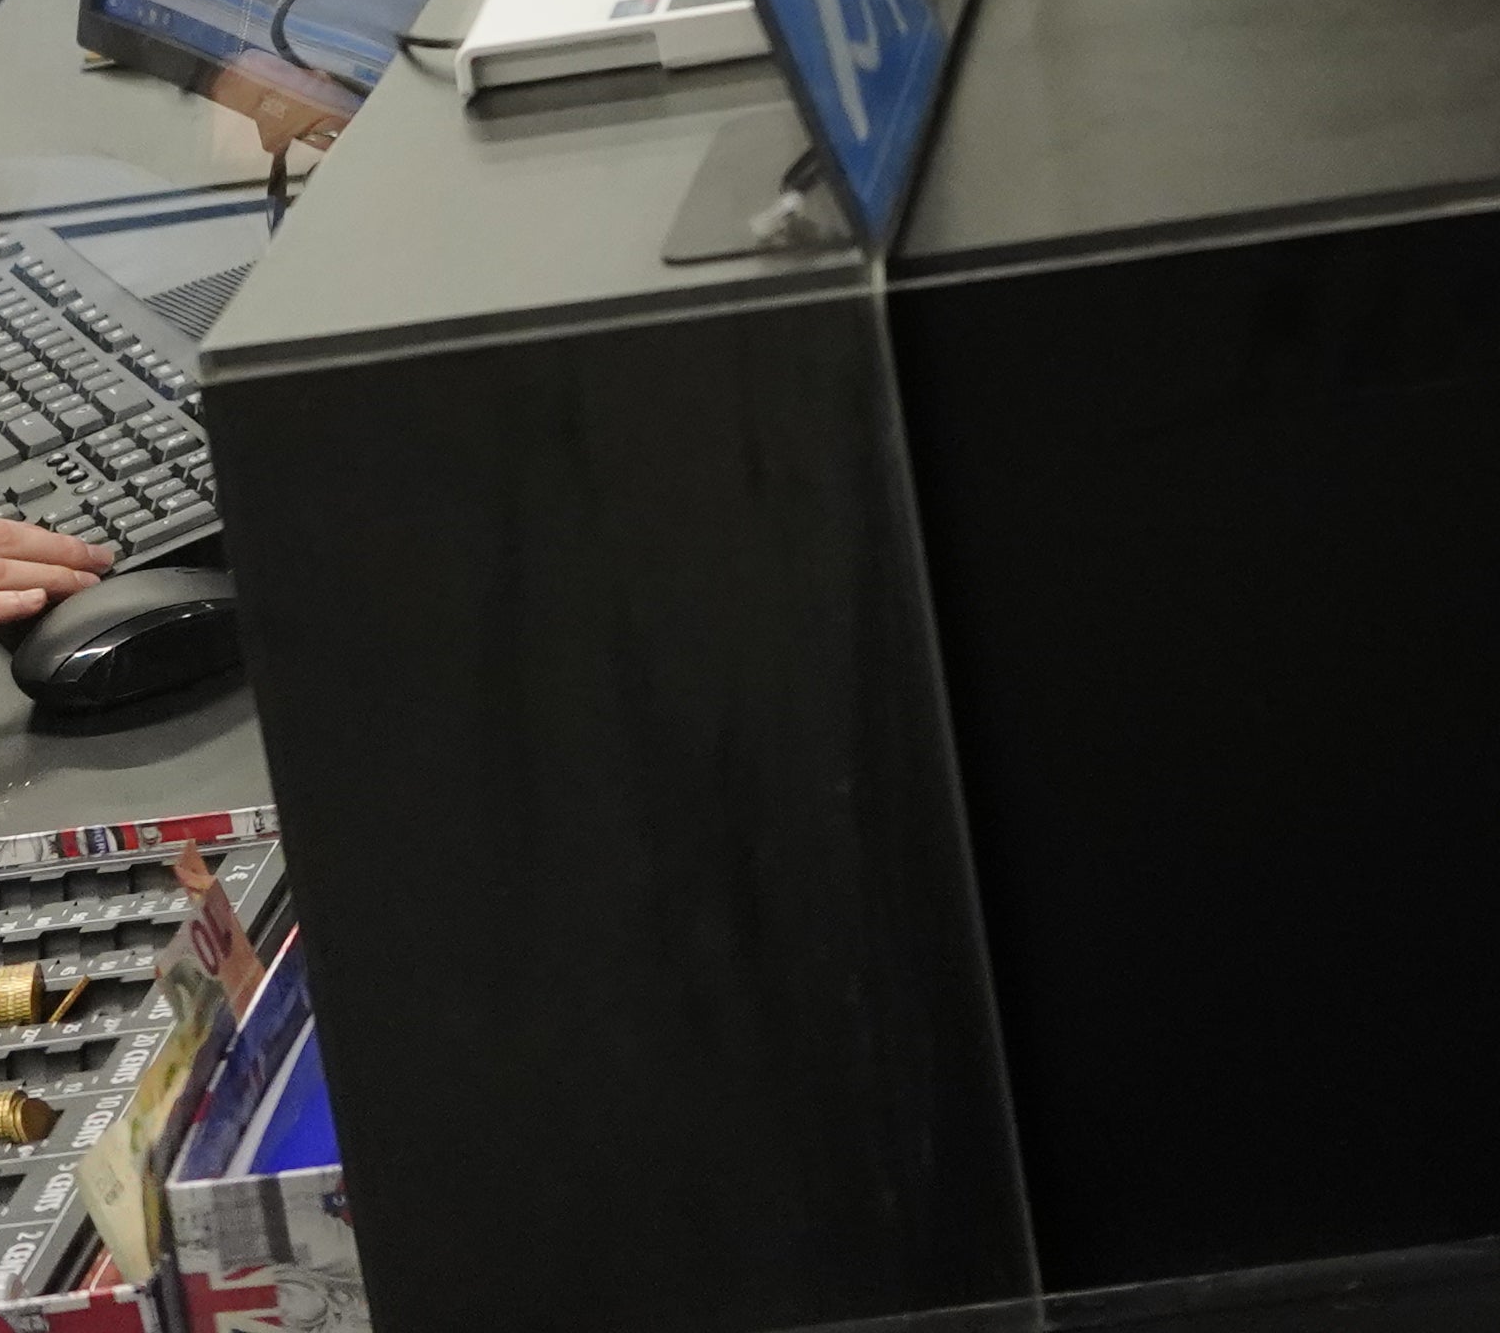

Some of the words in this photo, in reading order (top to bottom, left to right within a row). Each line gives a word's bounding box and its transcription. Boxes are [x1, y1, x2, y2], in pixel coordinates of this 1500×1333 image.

[190, 904, 233, 976] 10
[131, 1033, 160, 1048] 20
[109, 1048, 151, 1085] CENTS
[94, 1094, 124, 1110] 10
[70, 1110, 115, 1149] CENTS
[33, 1173, 75, 1213] CENTS
[16, 1230, 44, 1242] 2
